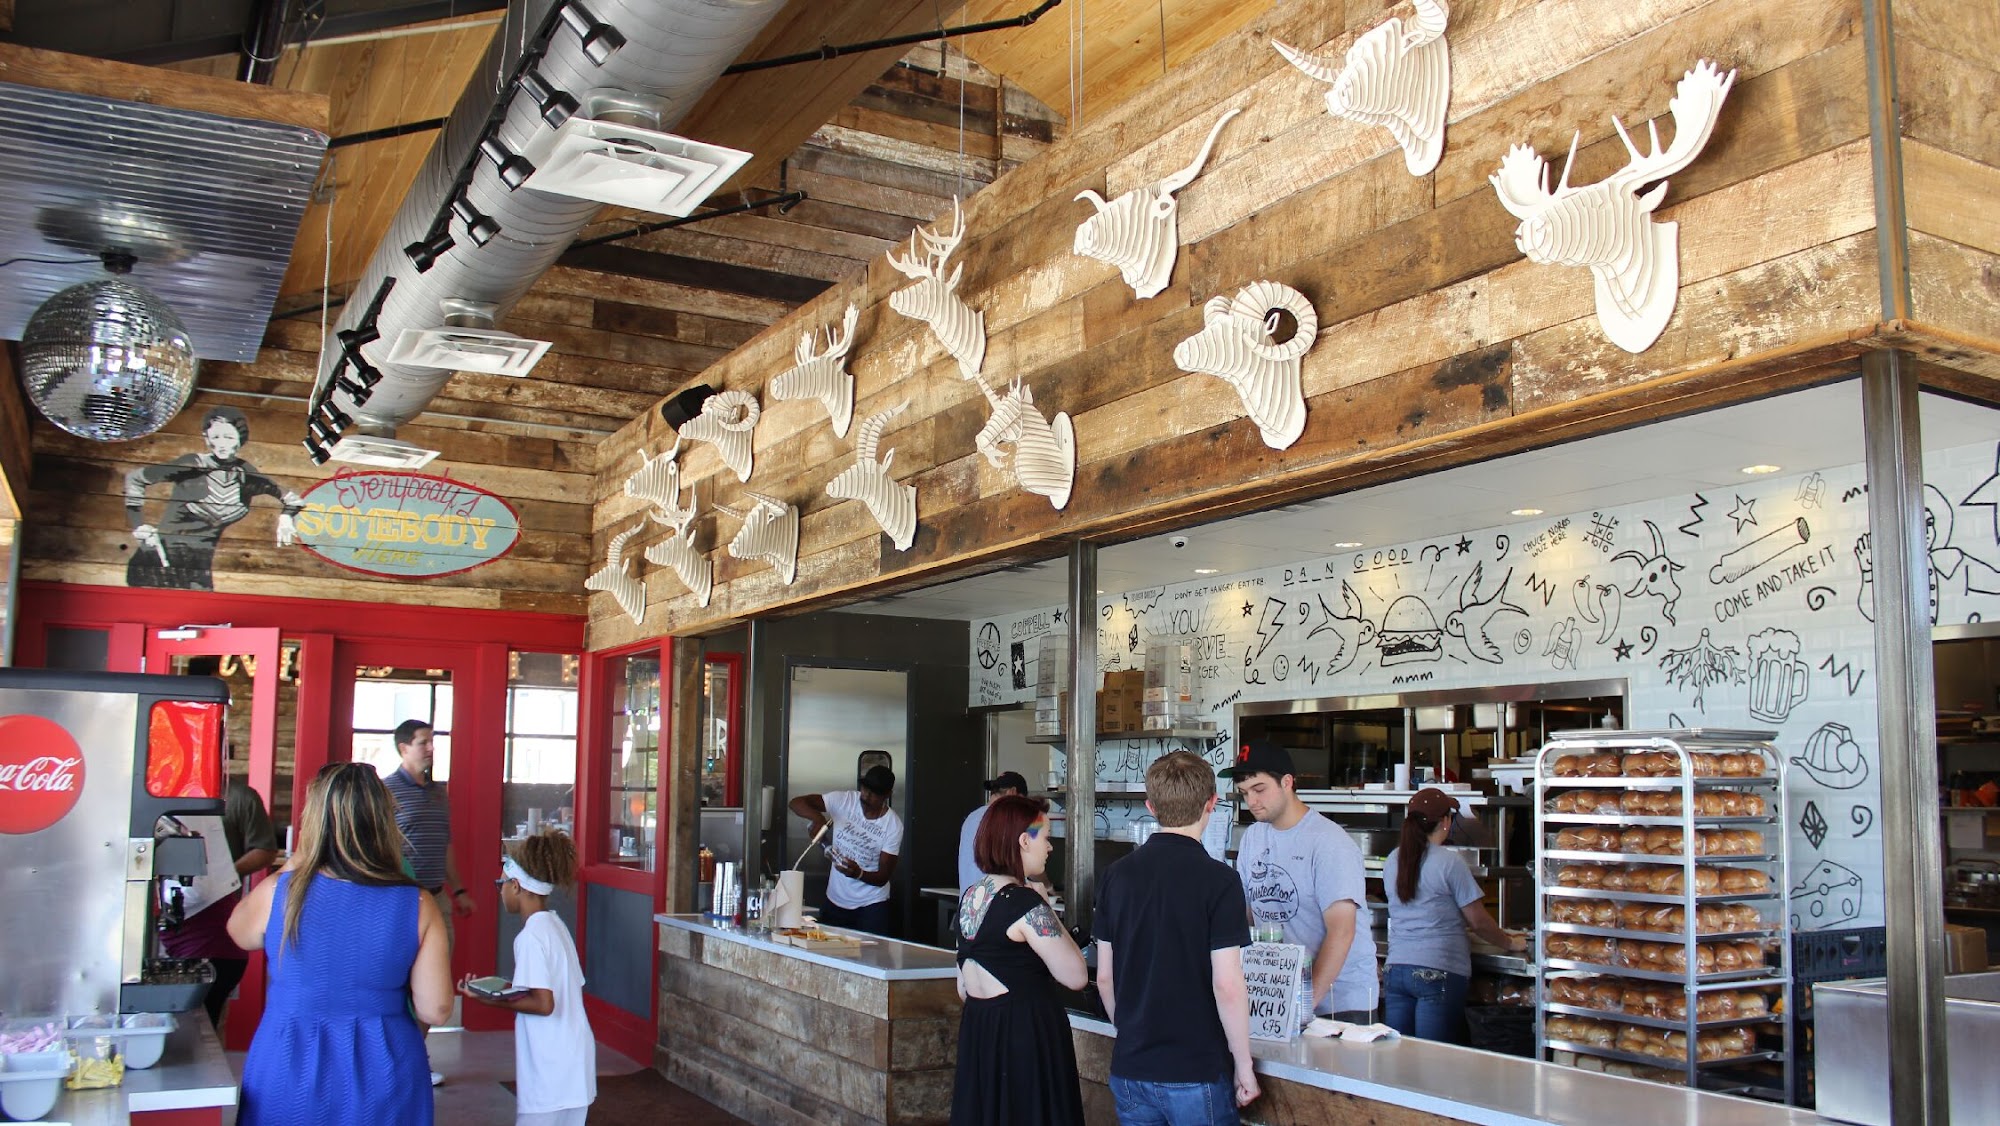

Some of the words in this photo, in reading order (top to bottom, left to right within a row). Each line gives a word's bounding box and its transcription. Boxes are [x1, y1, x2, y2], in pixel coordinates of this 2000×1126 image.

[334, 465, 483, 518] Everybody's
[296, 503, 496, 550] SOMEBODY
[1522, 533, 1546, 553] CHUCK
[1531, 542, 1549, 558] WUZ
[1550, 531, 1568, 547] HERE
[1353, 548, 1413, 573] GOOD
[1174, 588, 1193, 601] DON'T
[1194, 587, 1209, 597] GET
[1237, 579, 1251, 590] EAT
[1714, 588, 1753, 623] COME
[1755, 575, 1783, 601] AND
[1780, 555, 1819, 585] TAKE
[1819, 544, 1836, 567] IT
[1010, 612, 1052, 640] COPPELL
[1169, 608, 1200, 635] YOU
[0, 756, 82, 791] a-Cola
[1279, 958, 1297, 971] EASY
[1244, 971, 1268, 984] HOUSE
[1270, 974, 1291, 987] MADE
[1248, 998, 1274, 1018] NCH
[1277, 1000, 1286, 1017] IS
